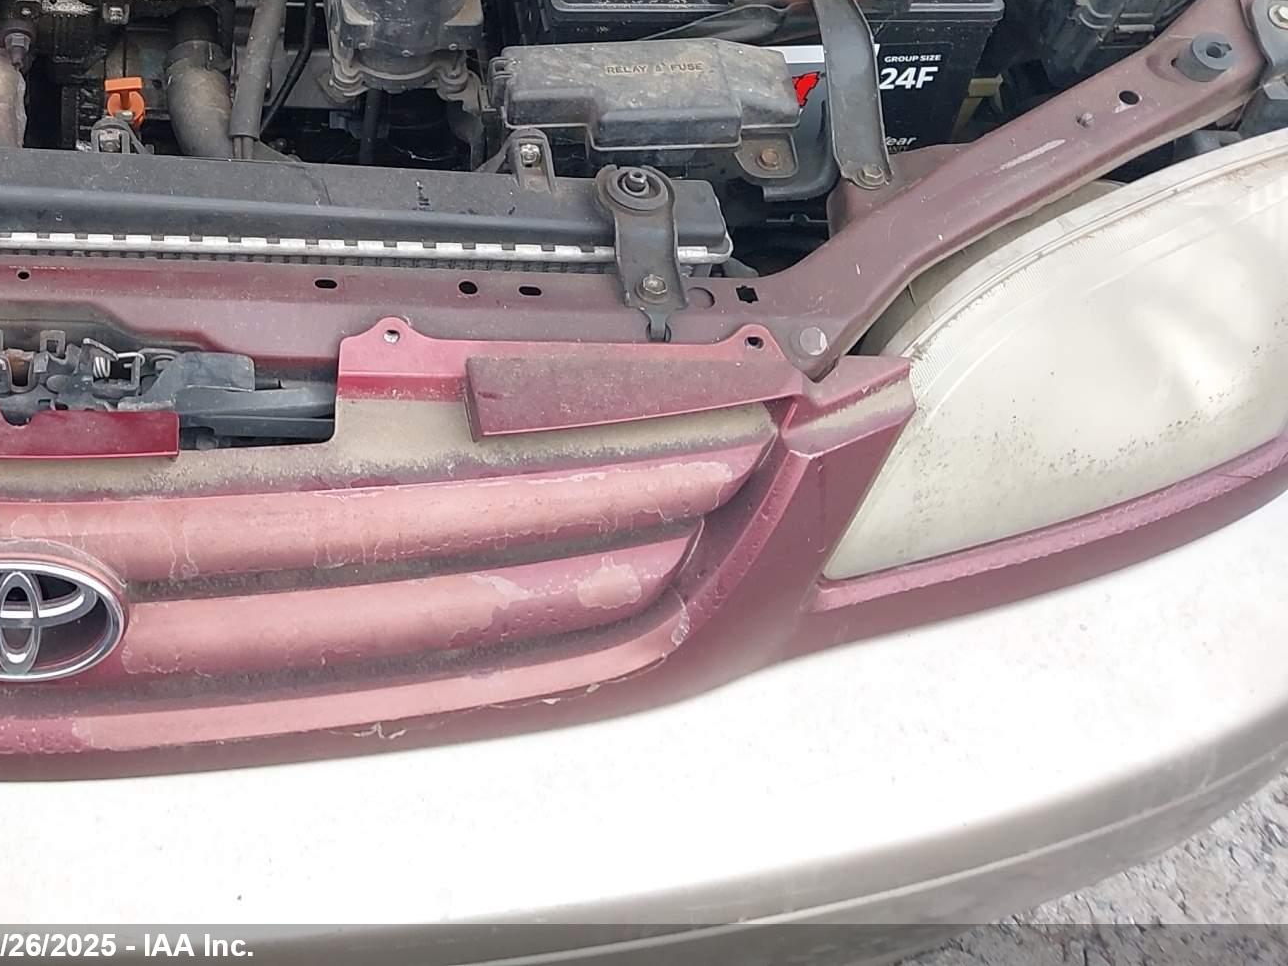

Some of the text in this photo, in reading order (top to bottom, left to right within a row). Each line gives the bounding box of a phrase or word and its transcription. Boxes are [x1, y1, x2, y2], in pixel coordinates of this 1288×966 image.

[884, 54, 942, 63] GROUP SIZE
[606, 64, 647, 74] RELAY
[670, 62, 704, 72] FUSE
[879, 66, 939, 90] 24F
